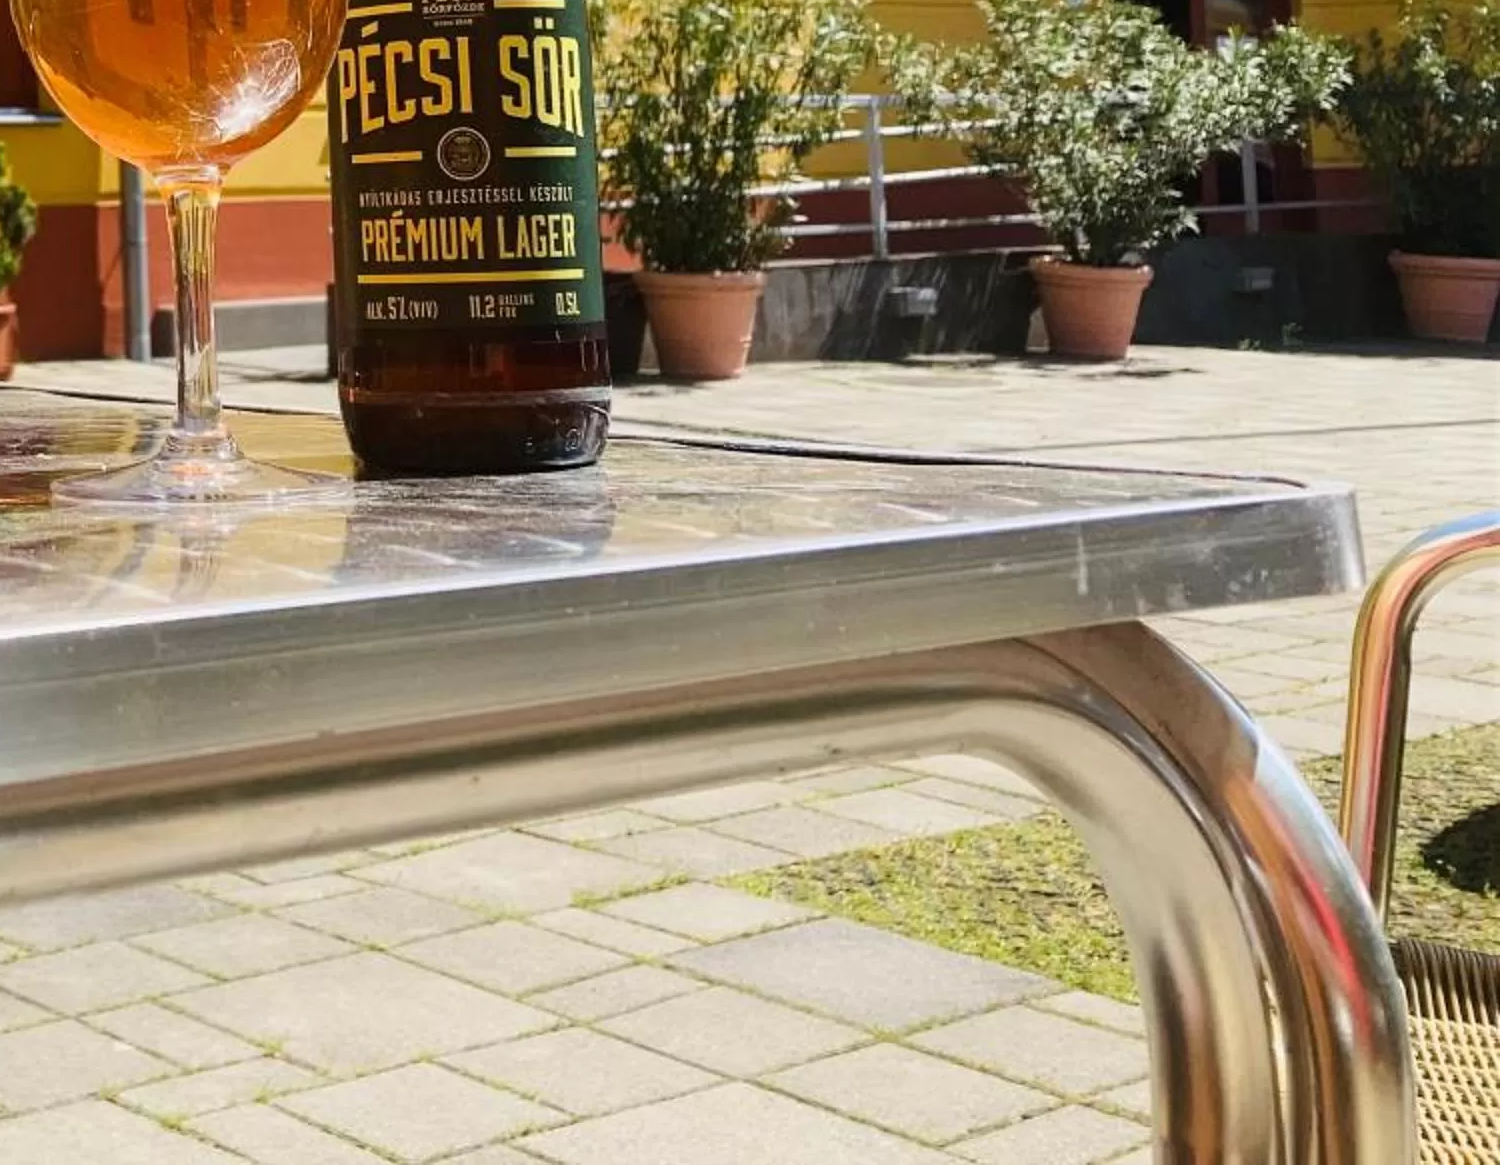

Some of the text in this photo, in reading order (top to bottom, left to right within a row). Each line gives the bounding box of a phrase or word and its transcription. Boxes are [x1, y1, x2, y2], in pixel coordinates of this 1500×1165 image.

[337, 17, 584, 144] PÉCSI SÖR
[361, 209, 577, 262] PRÉMIUM LAGER
